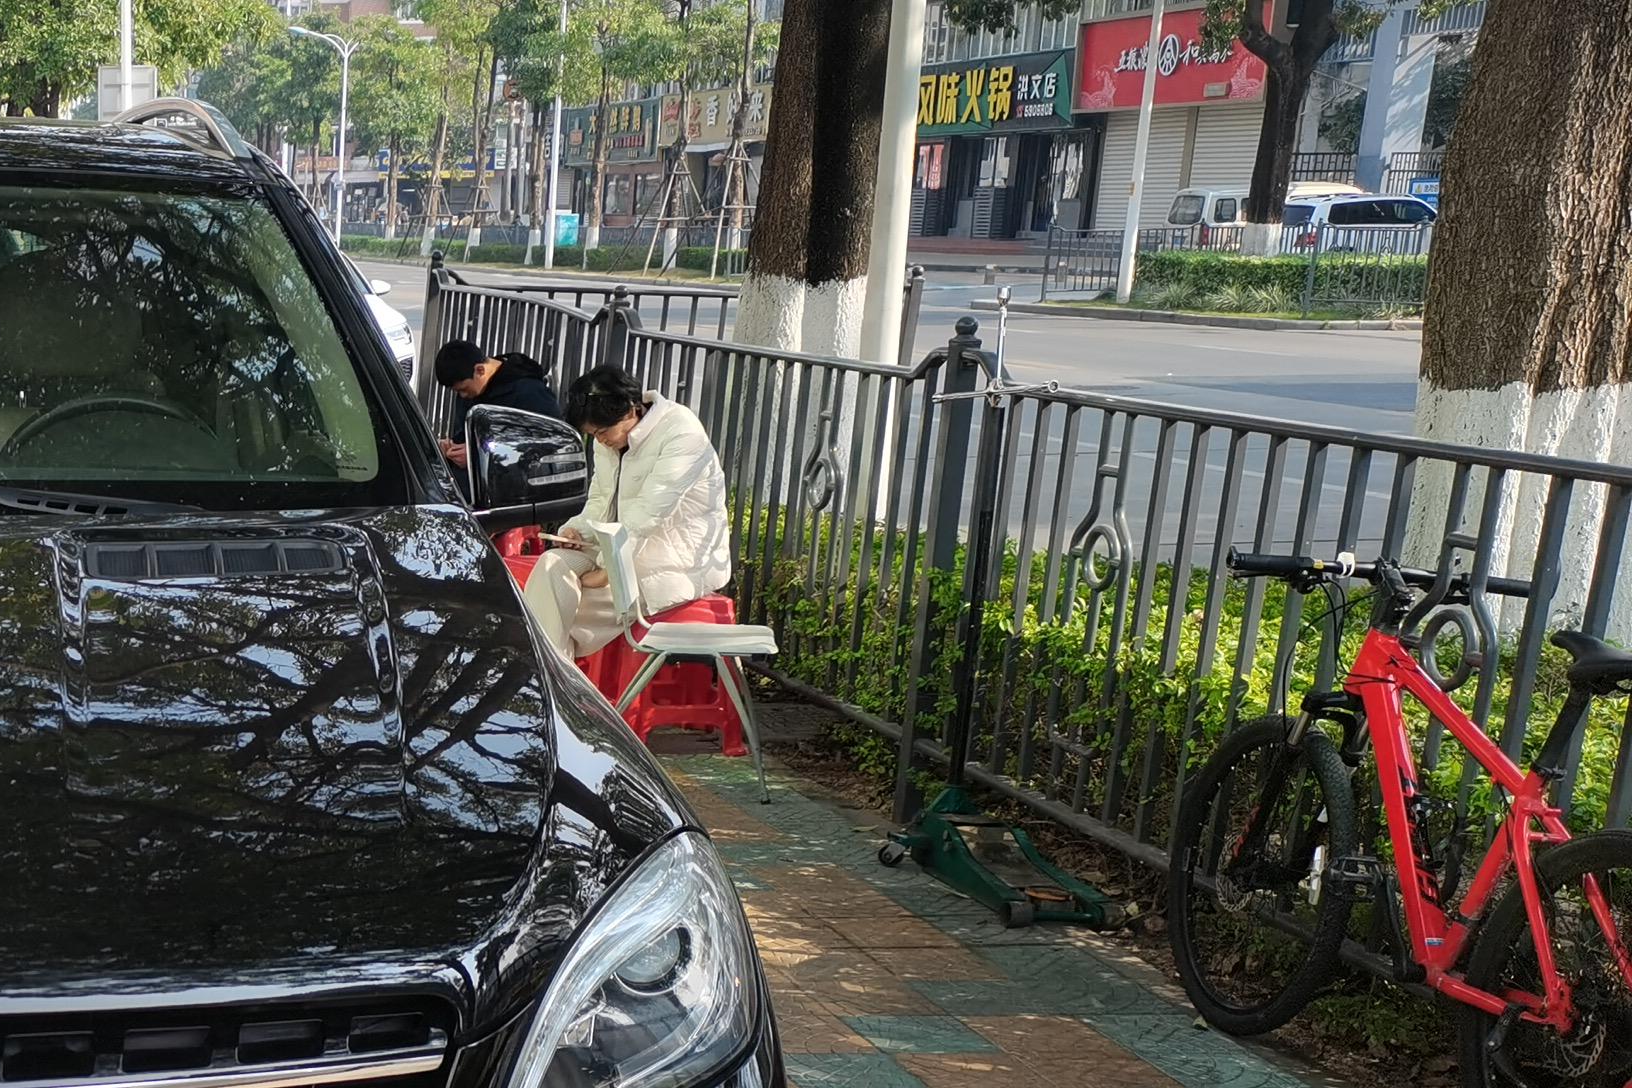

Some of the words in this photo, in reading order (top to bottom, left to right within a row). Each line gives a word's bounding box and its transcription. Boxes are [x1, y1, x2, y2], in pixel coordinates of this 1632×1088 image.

[918, 66, 1014, 126] 风味火锅
[1017, 73, 1057, 100] 洪文店
